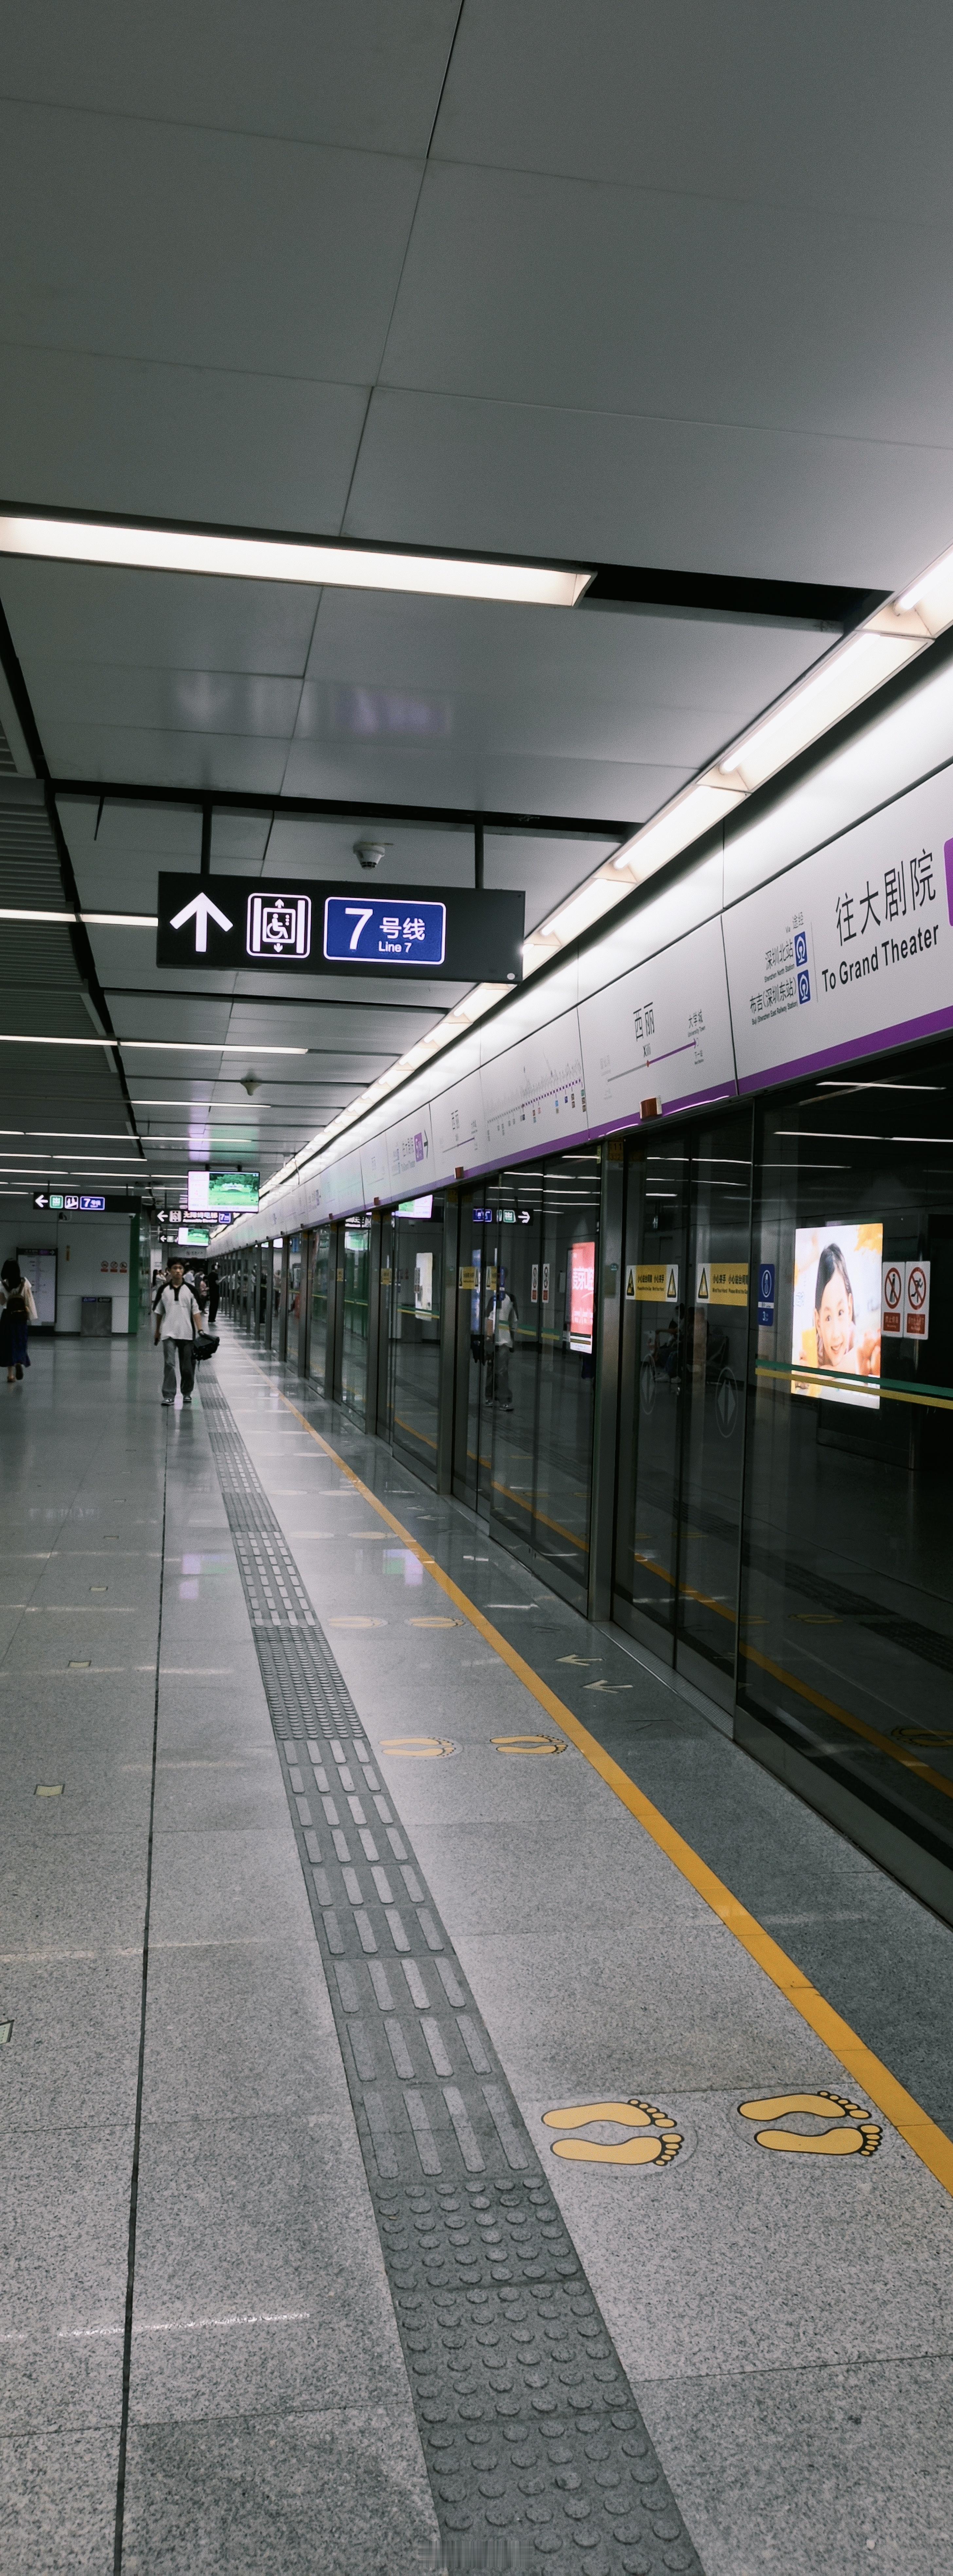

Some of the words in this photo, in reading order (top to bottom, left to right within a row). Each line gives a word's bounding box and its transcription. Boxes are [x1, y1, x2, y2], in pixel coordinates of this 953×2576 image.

[836, 848, 936, 946] 往大剧院
[378, 941, 402, 953] Line
[404, 942, 412, 953] 7
[765, 939, 793, 970] 深圳北站
[822, 969, 836, 992] To
[839, 946, 879, 985] Grand
[881, 925, 938, 966] Theater
[633, 1002, 655, 1041] 西丽
